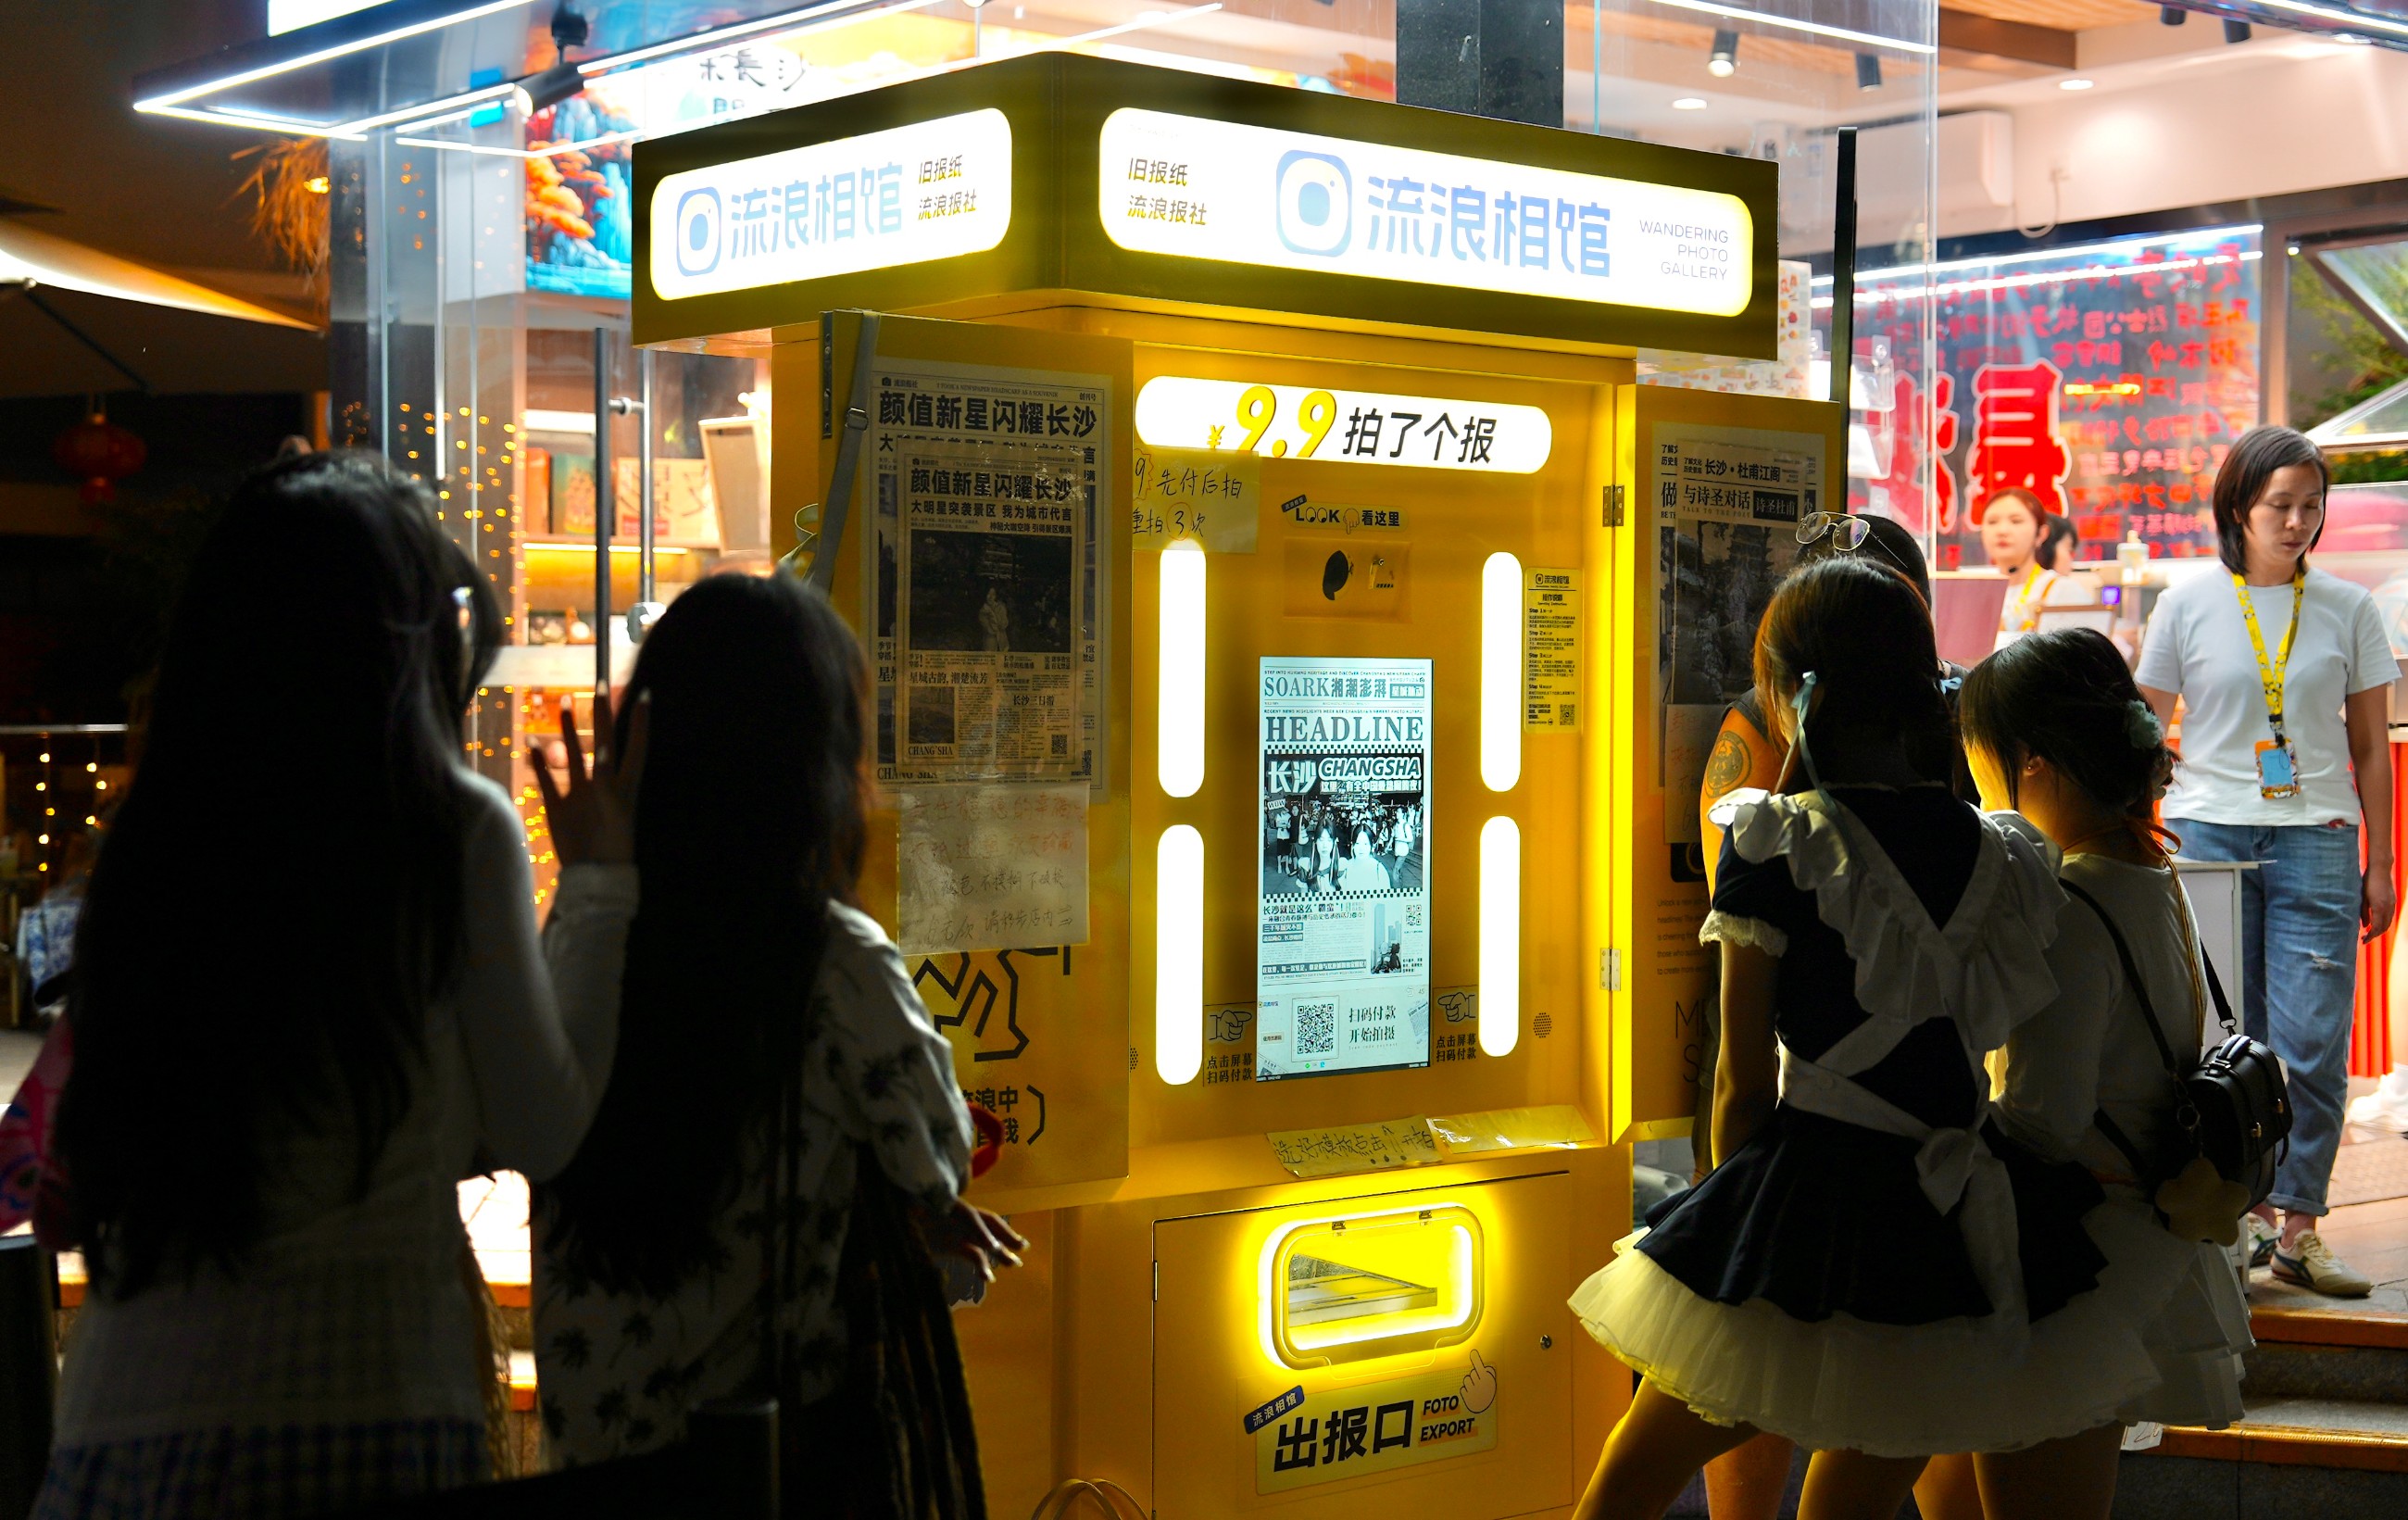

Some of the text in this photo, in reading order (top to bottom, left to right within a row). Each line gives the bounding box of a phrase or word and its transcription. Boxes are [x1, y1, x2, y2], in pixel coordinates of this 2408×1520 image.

[918, 155, 963, 184] 旧报纸
[1128, 157, 1188, 186] 旧报纸
[731, 161, 903, 259] 流浪相馆
[918, 189, 977, 220] 流浪报社
[1127, 195, 1207, 225] 流浪报社
[1367, 176, 1611, 277] 流浪相馆
[1639, 220, 1729, 244] WANDERING
[1677, 245, 1729, 262] PHOTO
[1661, 262, 1727, 281] GALLERY
[879, 391, 1097, 437] 颜值新星闪耀长沙
[1342, 407, 1498, 464] 拍了个报
[910, 468, 1072, 501] 颜值新星闪耀长沙
[1157, 468, 1242, 499] 先付后拍
[1684, 484, 1750, 509] 与诗圣对话
[1755, 496, 1795, 516] 诗圣杜甫
[910, 499, 1072, 521] 大明星突袭景区 我为城市代言
[1296, 507, 1340, 523] LOOK
[1361, 509, 1400, 526] 看这里
[1264, 677, 1331, 697] SOARK
[1266, 716, 1423, 741] HEADLINE
[1268, 760, 1317, 794] 长沙
[1321, 759, 1421, 777] CHANGSHA
[1349, 1005, 1397, 1023] 扫码付款
[1349, 1025, 1395, 1043] 开始拍摄
[1436, 1033, 1476, 1049] 点击屏幕
[1207, 1053, 1252, 1069] 点击屏幕
[1436, 1048, 1476, 1062] 扫码付款
[1207, 1068, 1252, 1085] 扫码付款
[1252, 1392, 1297, 1426] 流浪相馆
[1423, 1395, 1460, 1415] FOTO
[1273, 1401, 1414, 1473] 出报口
[1420, 1417, 1474, 1442] EXPORT
